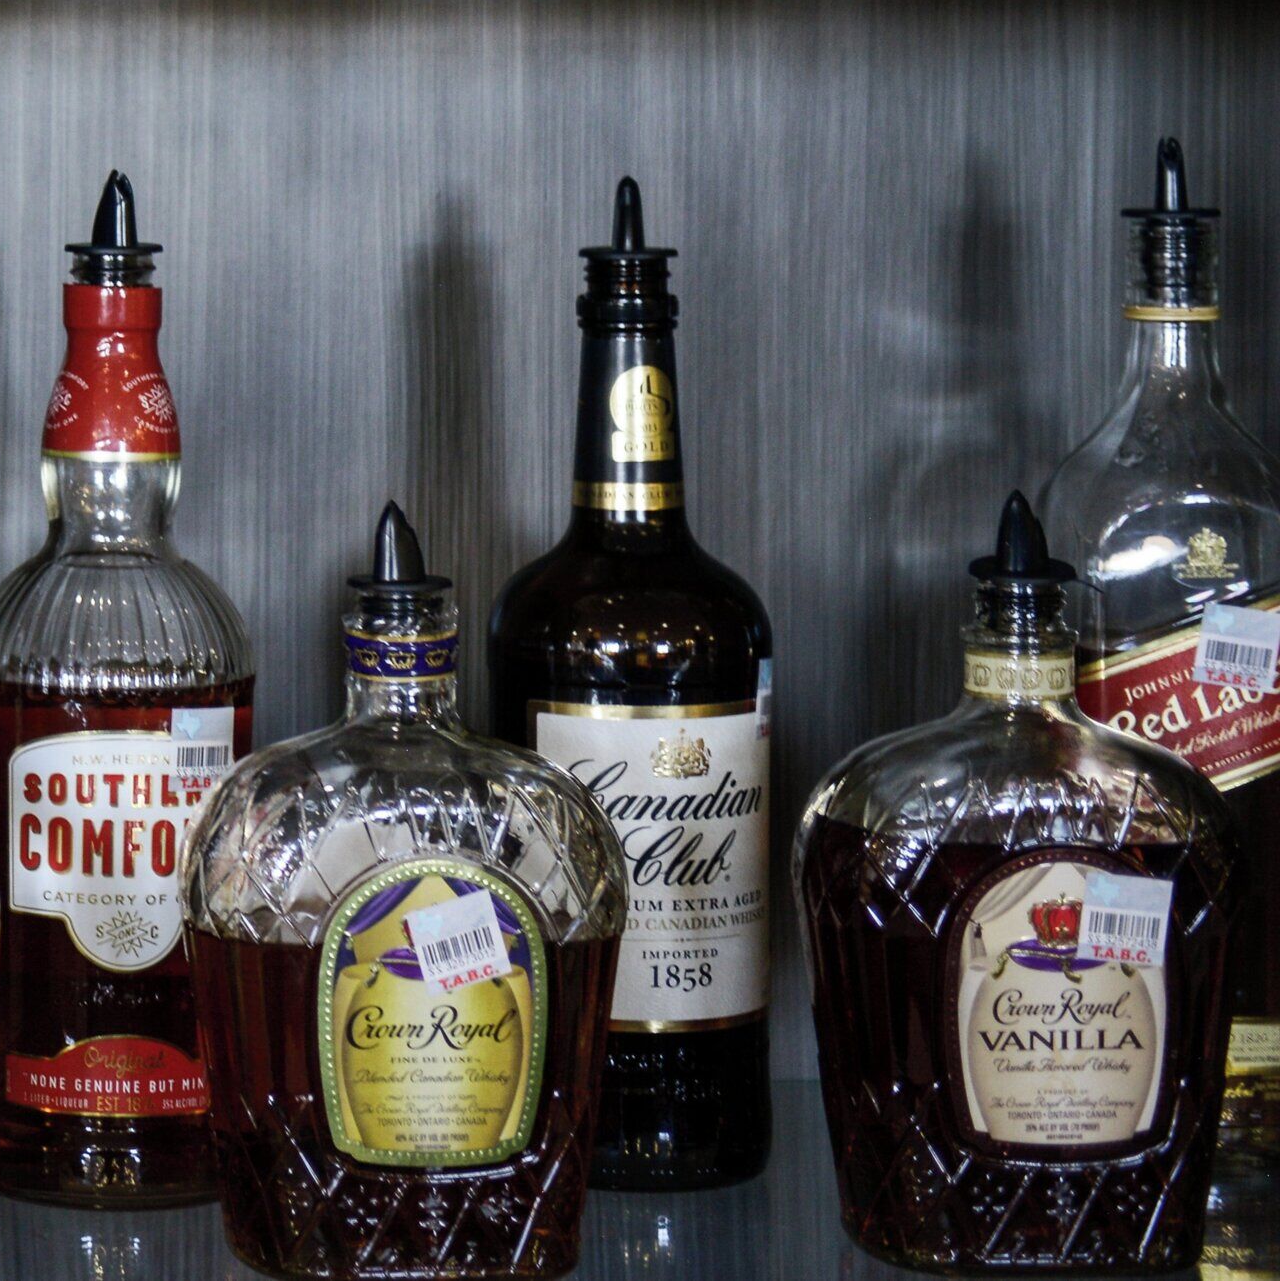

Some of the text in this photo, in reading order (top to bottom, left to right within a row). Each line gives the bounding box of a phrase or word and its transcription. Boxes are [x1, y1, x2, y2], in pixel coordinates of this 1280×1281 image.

[1104, 694, 1191, 741] Red
[622, 825, 737, 887] Club
[43, 889, 167, 906] CATEGORY OF
[672, 897, 729, 912] EXTRA
[643, 915, 728, 932] CANADIAN
[118, 926, 137, 940] ONE
[641, 948, 719, 960] IMPORTED
[1092, 944, 1152, 964] T.A.B.C.
[439, 964, 500, 991] T.A.B.C.
[650, 962, 713, 992] 1858
[992, 988, 1132, 1026] Crown Royal
[347, 1004, 517, 1051] Crown Royal
[978, 1029, 1144, 1051] VANILLA
[390, 1056, 418, 1064] FINE
[443, 1056, 473, 1064] LUXE
[74, 1079, 174, 1094] GENUINE BUT
[96, 1096, 119, 1112] EST
